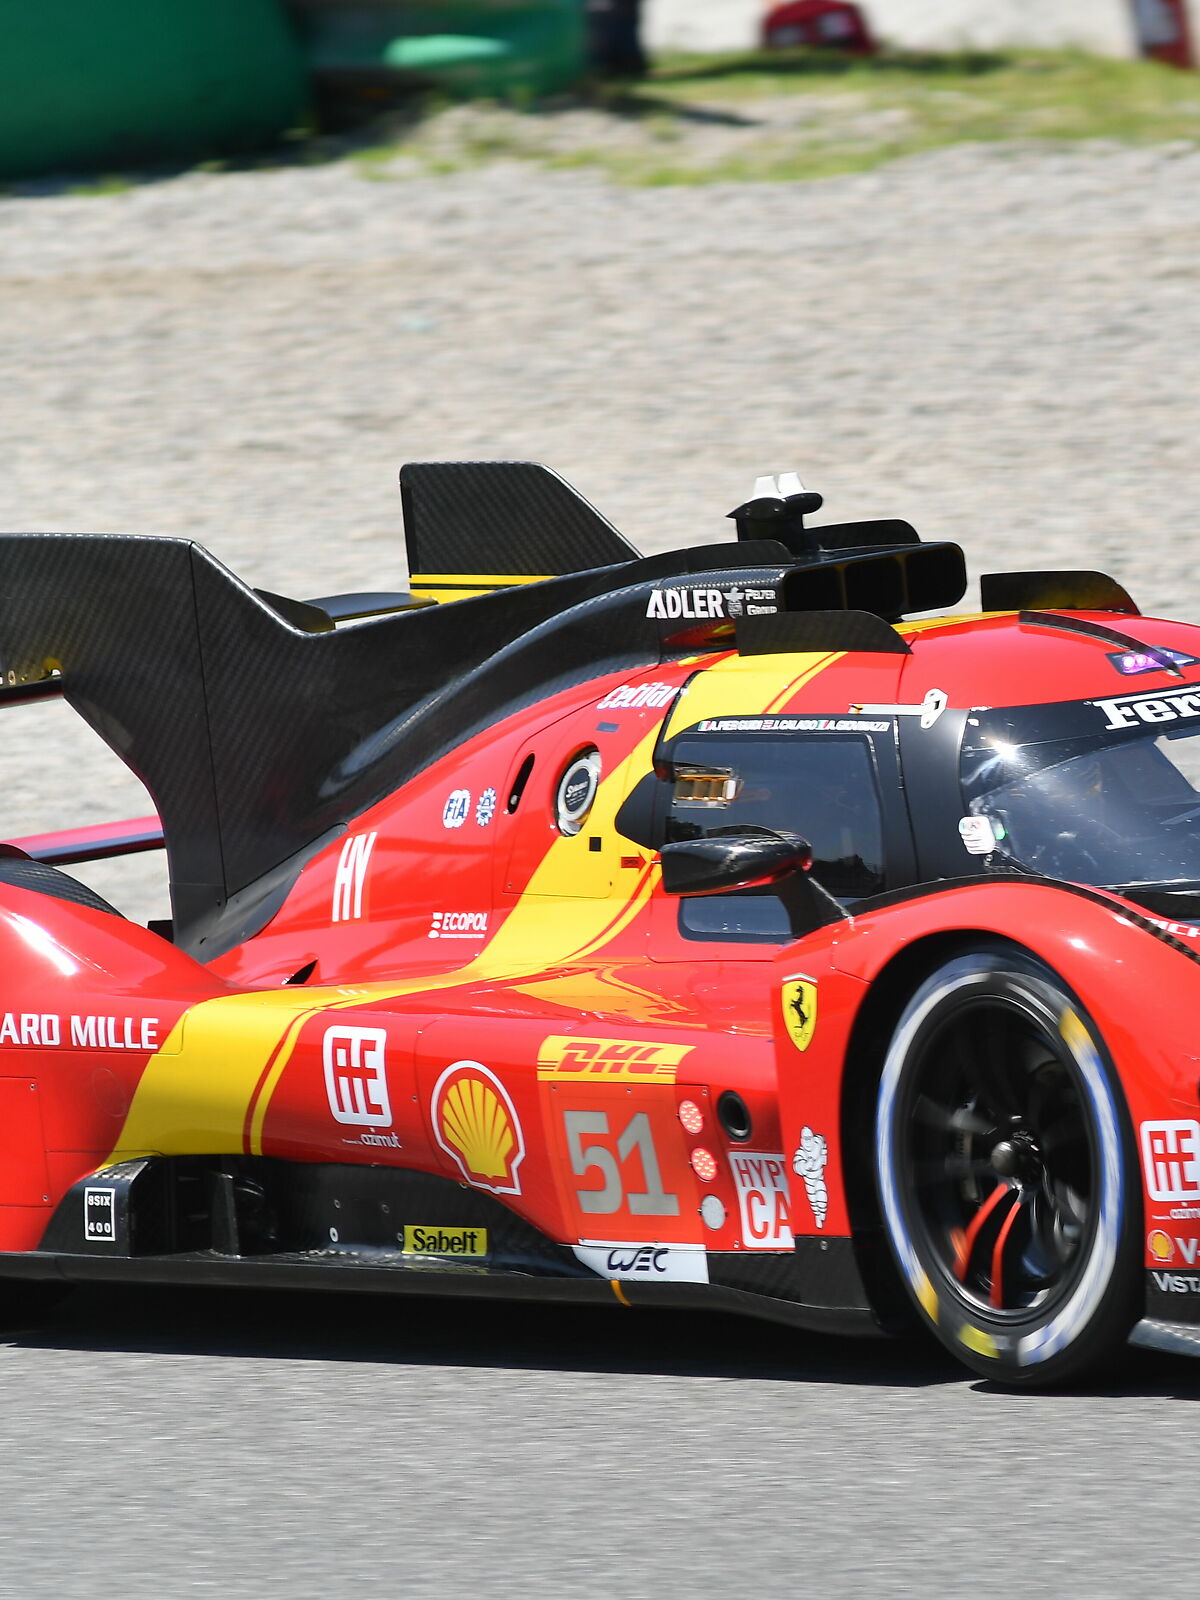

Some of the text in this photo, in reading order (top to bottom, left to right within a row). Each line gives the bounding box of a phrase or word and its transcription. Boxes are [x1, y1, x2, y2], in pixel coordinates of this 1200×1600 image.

[645, 588, 725, 619] ADLER
[596, 682, 681, 710] Cetilar
[445, 798, 466, 820] FIA
[332, 831, 378, 922] HY
[442, 912, 488, 931] ECOPOL
[0, 1013, 159, 1050] ARD MILLE
[557, 1042, 664, 1074] DHL
[360, 1127, 403, 1149] azimut
[563, 1110, 680, 1216] 51
[88, 1195, 111, 1206] 8SIX
[89, 1222, 111, 1233] 400
[412, 1228, 478, 1254] Sabelt
[607, 1247, 670, 1272] WEC
